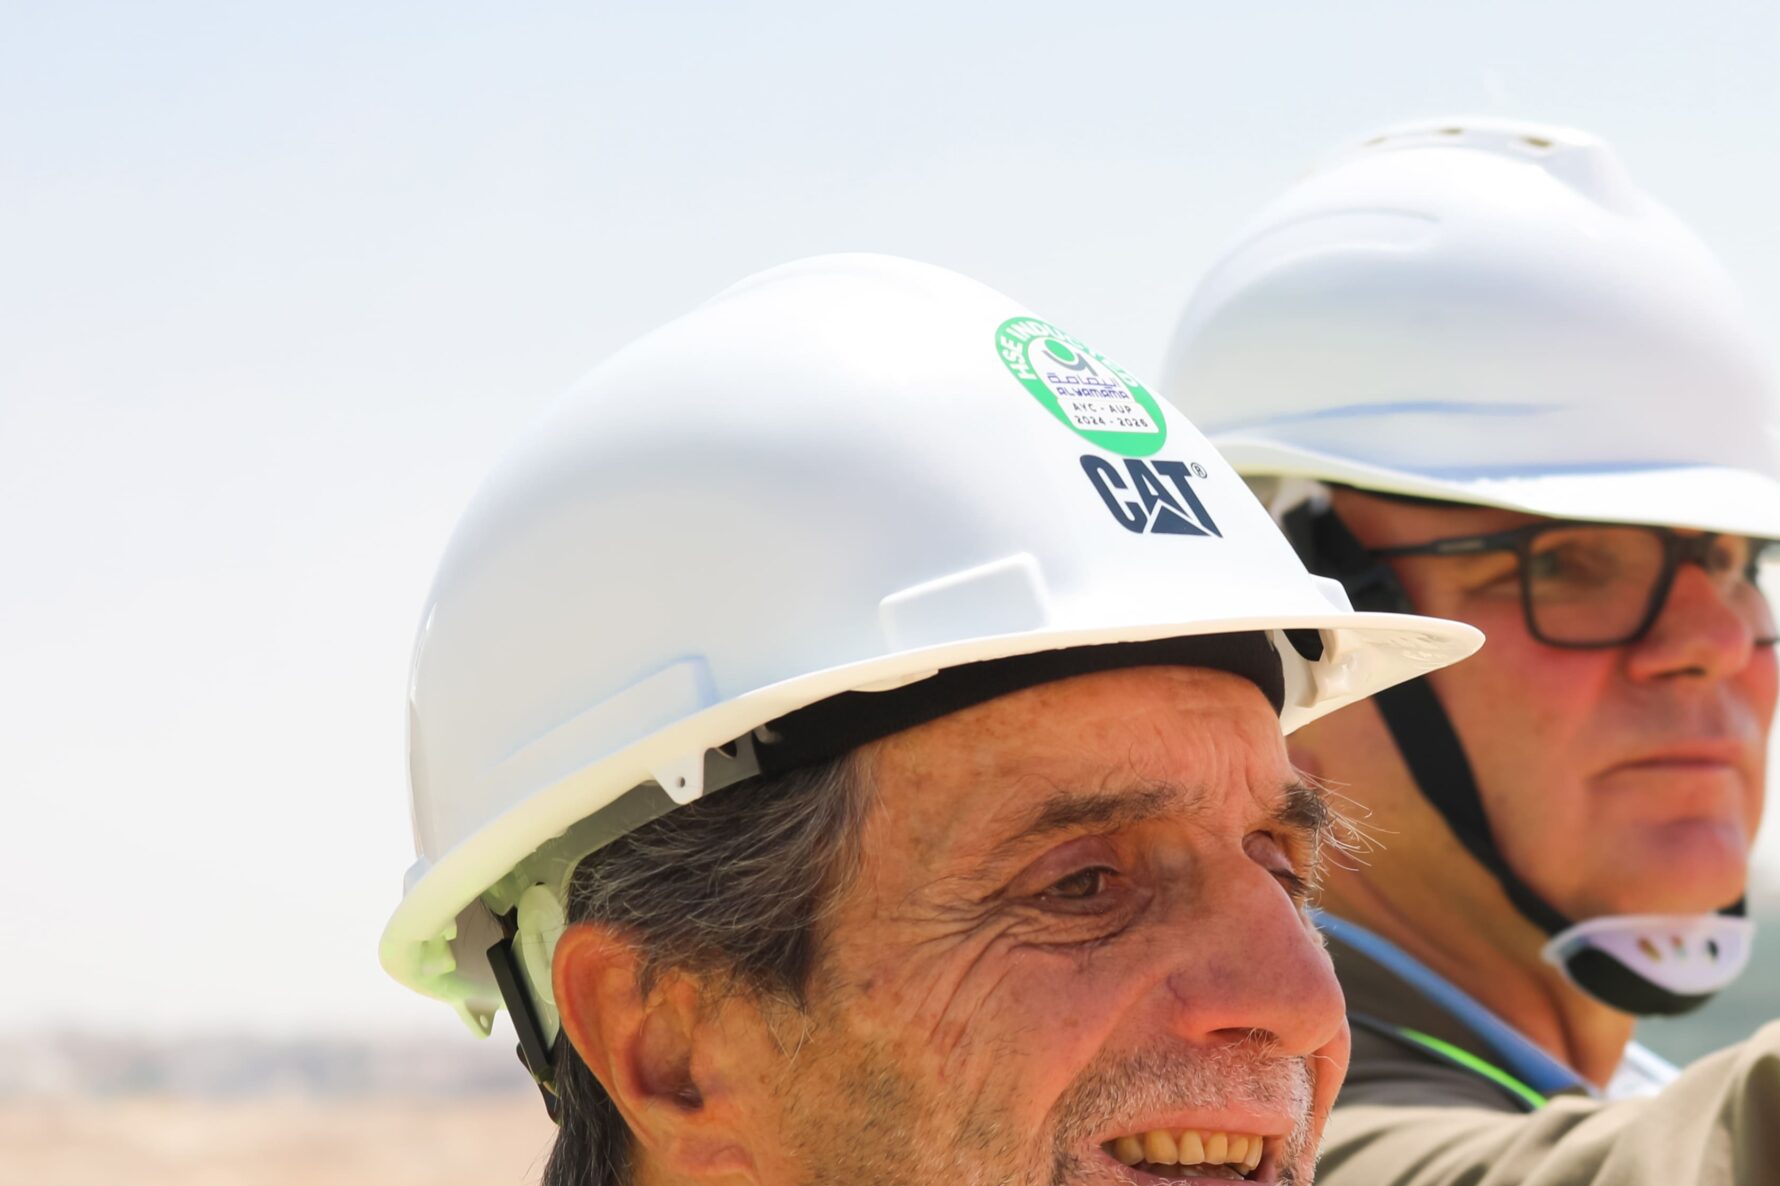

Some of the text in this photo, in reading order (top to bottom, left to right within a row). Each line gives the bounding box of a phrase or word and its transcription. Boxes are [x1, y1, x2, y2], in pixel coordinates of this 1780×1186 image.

[1000, 336, 1036, 379] HSE
[1047, 373, 1121, 390] اليمامة
[1072, 402, 1098, 413] AYC
[1109, 404, 1133, 414] AUP
[1075, 415, 1107, 426] 2024
[1117, 417, 1149, 428] 2026
